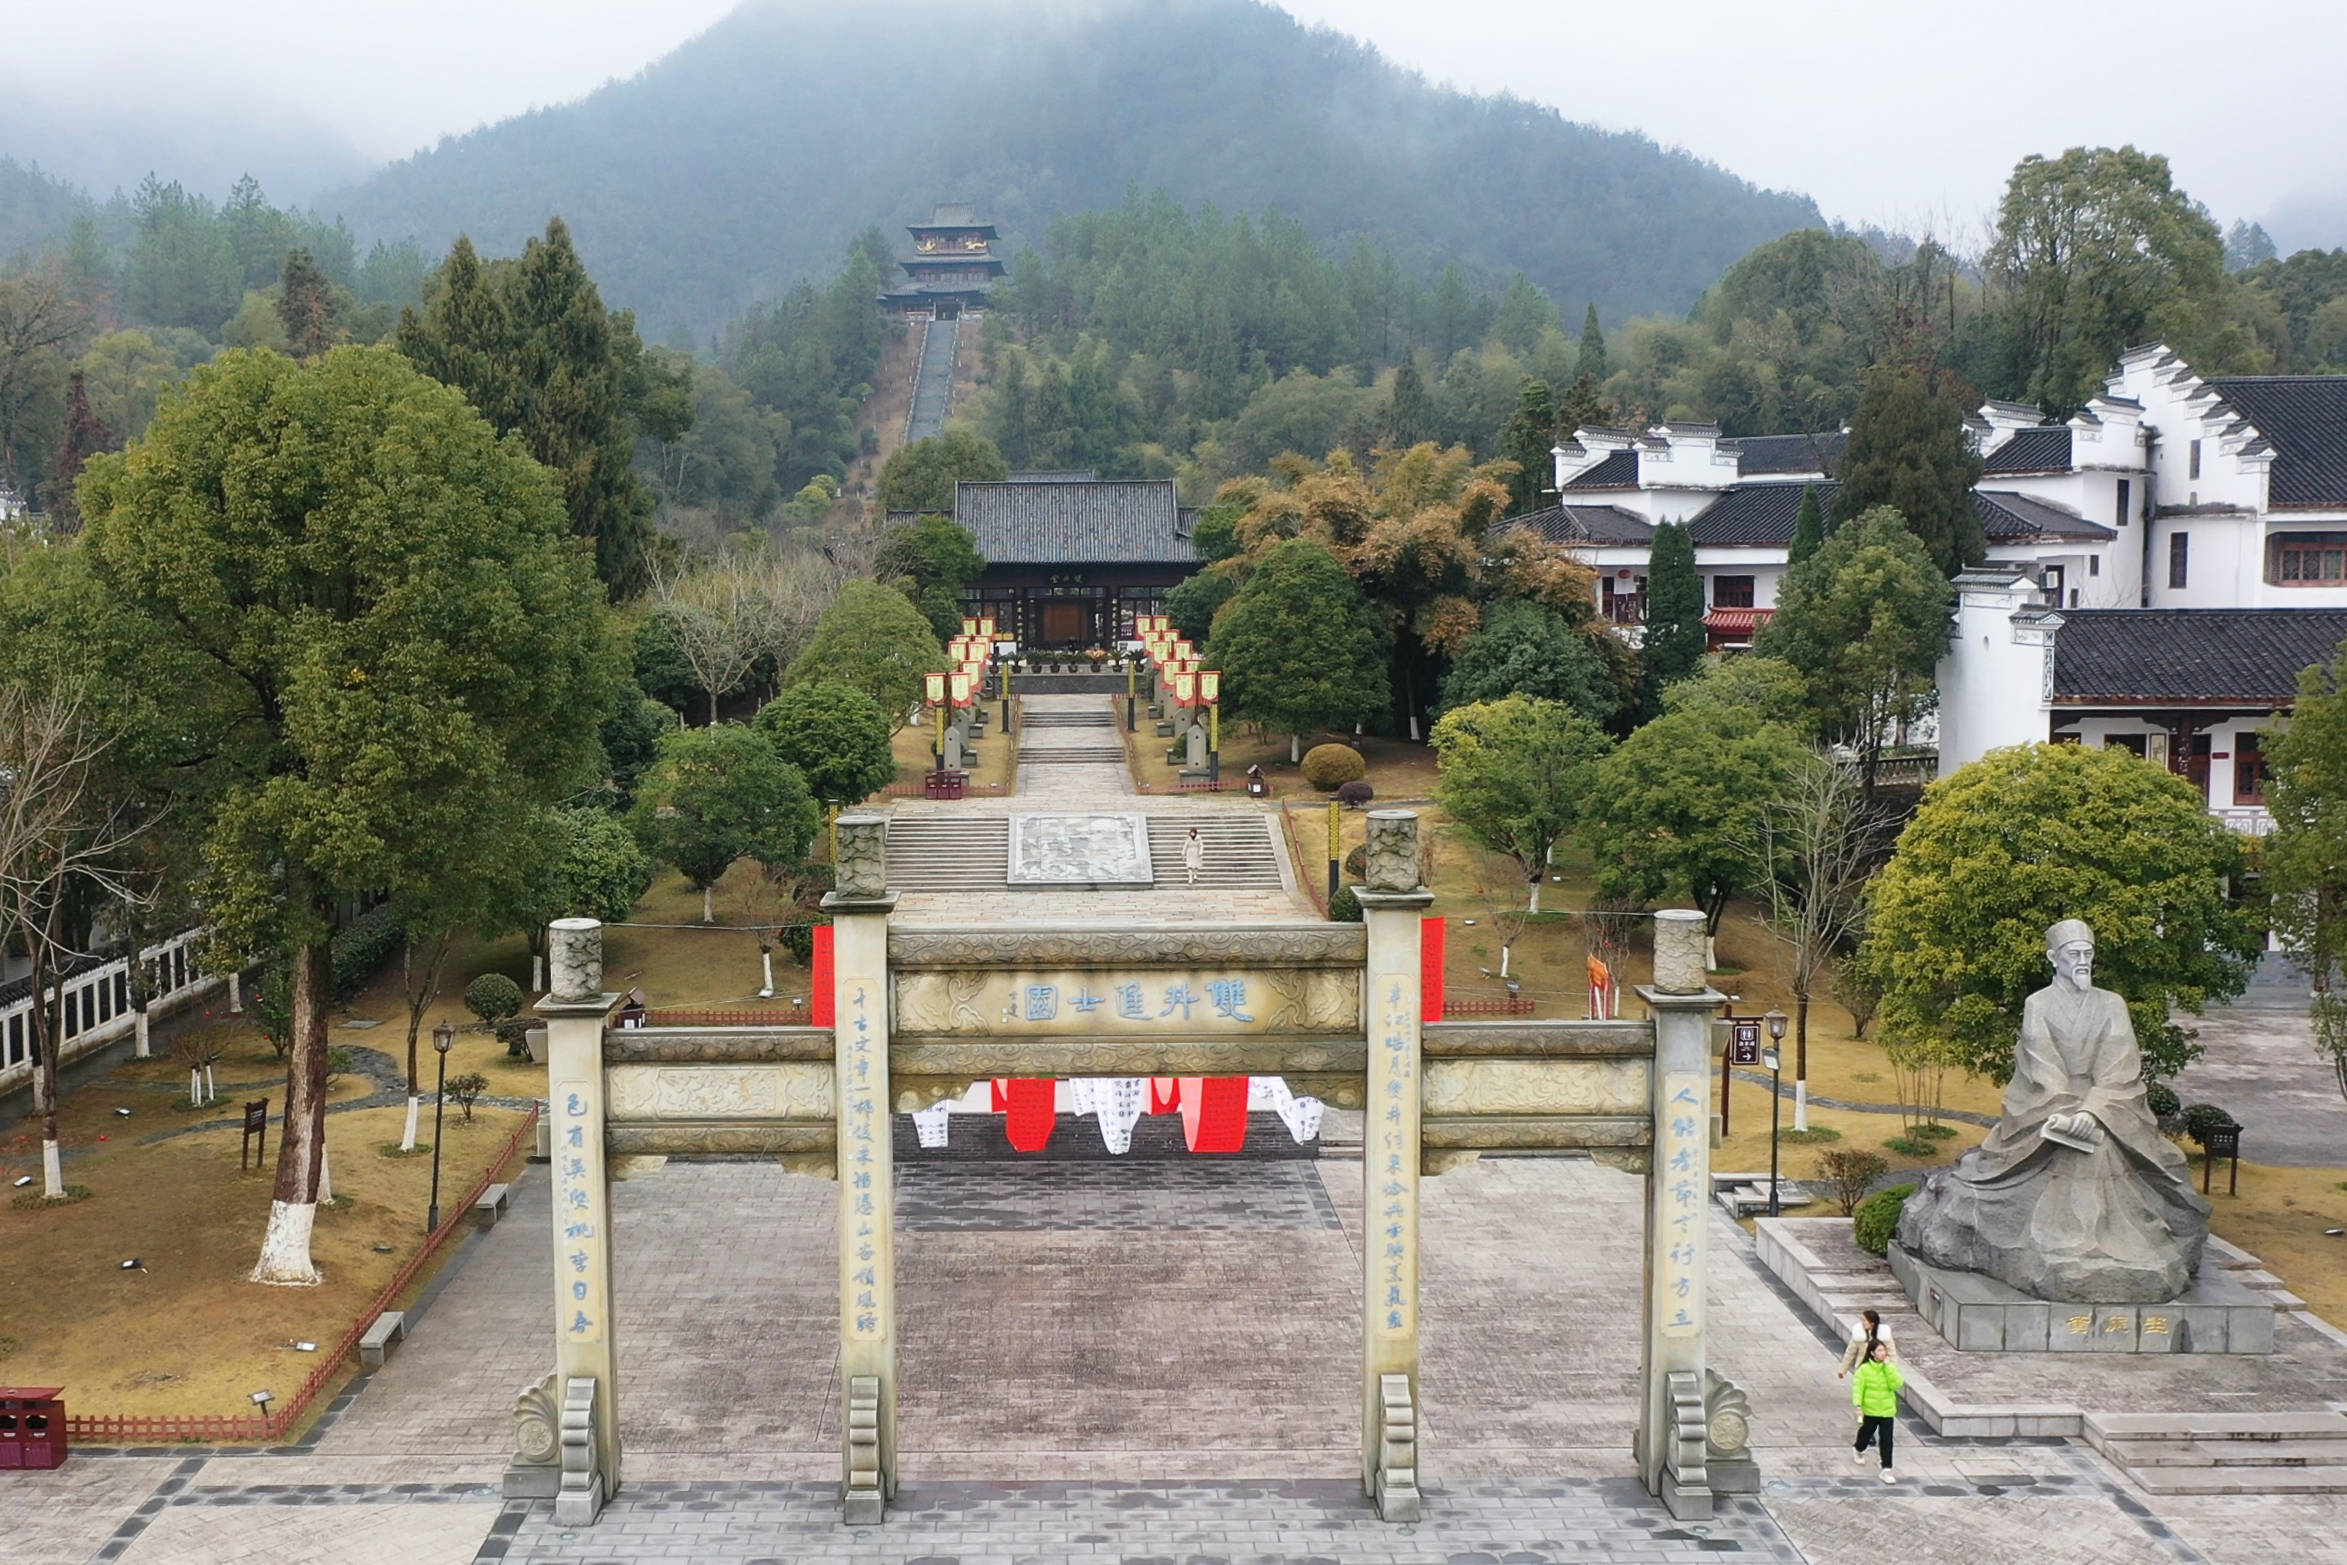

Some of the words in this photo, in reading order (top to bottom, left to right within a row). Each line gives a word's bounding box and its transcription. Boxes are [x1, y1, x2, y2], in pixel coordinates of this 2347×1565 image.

[1025, 979, 1255, 1024] 雙井進士園
